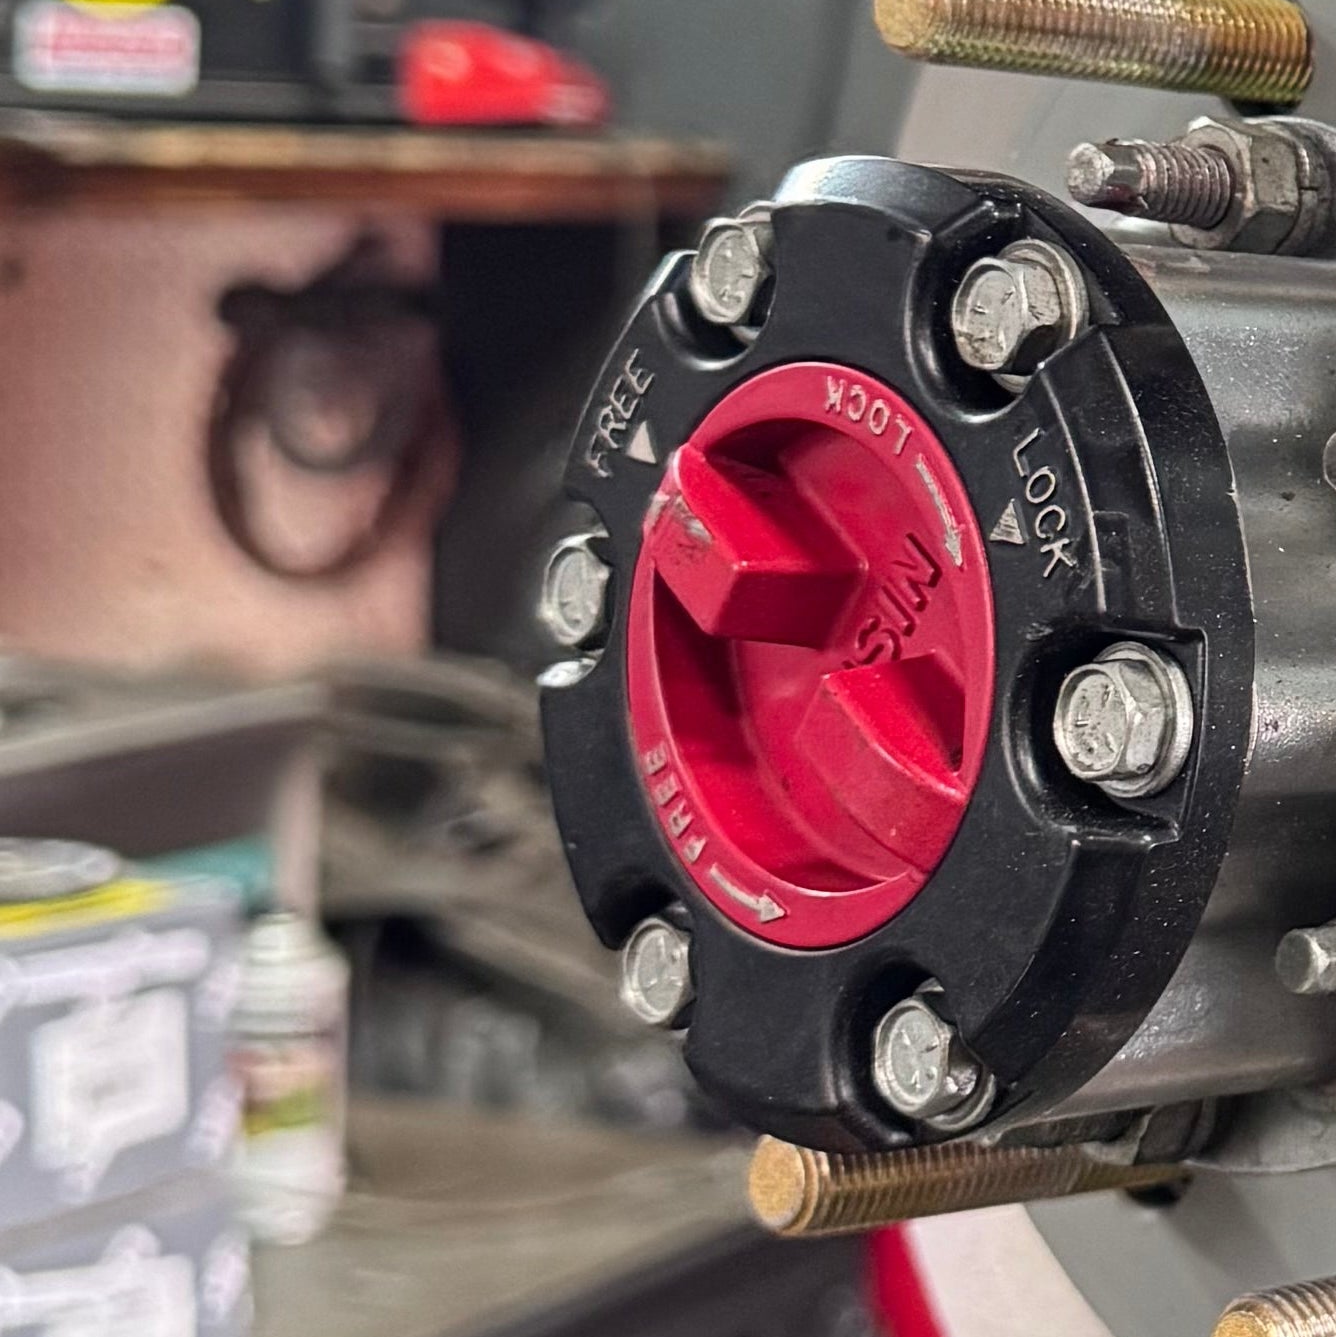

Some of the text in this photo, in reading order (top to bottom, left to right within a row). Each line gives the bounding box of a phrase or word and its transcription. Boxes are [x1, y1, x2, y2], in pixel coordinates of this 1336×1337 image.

[586, 347, 656, 478] FREE
[824, 374, 914, 456] LOCK
[1012, 426, 1078, 578] LOCK
[643, 740, 708, 865] FREE
